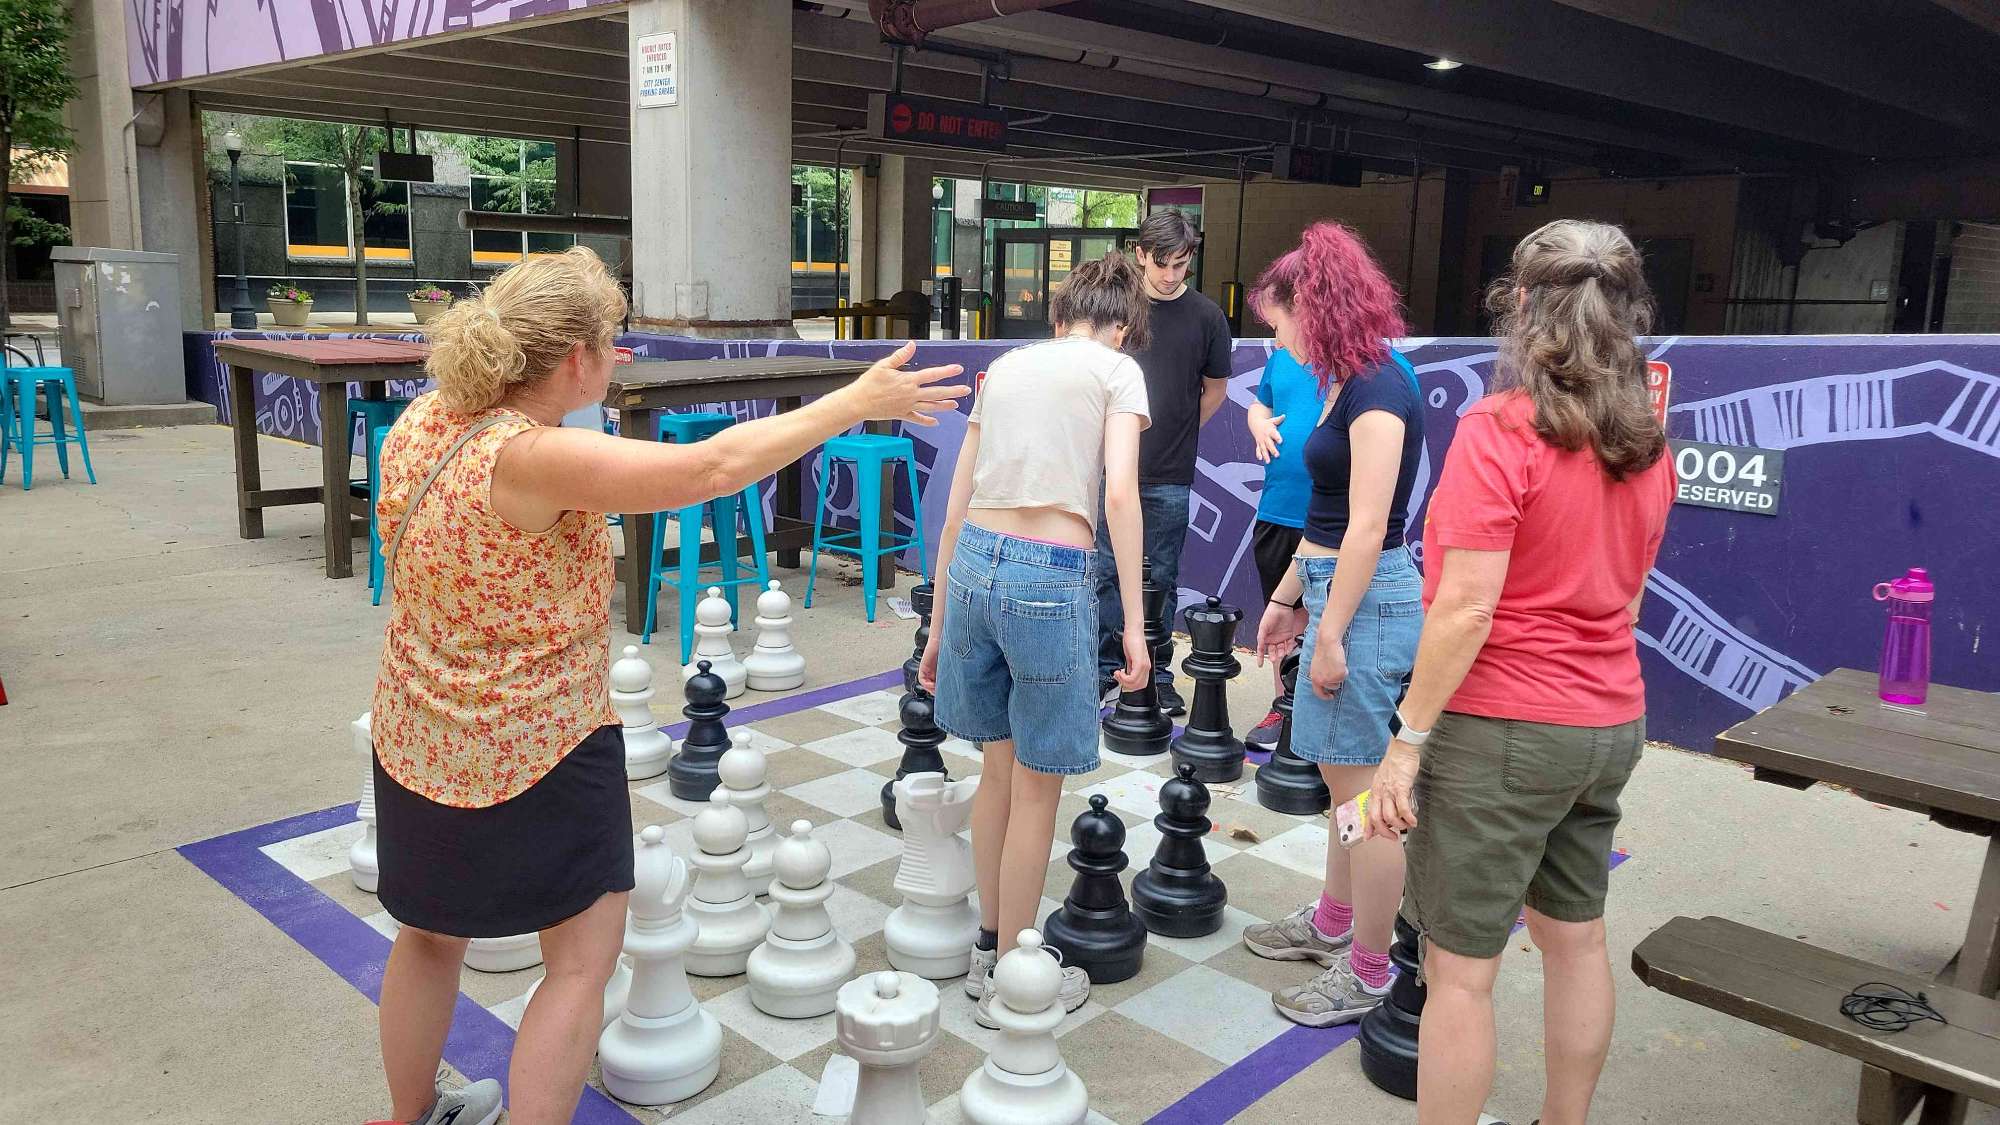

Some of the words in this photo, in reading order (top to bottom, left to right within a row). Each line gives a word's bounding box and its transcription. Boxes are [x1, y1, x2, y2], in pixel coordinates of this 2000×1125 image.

[640, 88, 658, 96] PARKING
[659, 87, 675, 95] GARAGE
[644, 80, 653, 88] CITY
[655, 78, 670, 87] CENTER
[917, 111, 936, 130] DO
[940, 115, 961, 135] NOT
[1533, 185, 1543, 195] EXIT
[1675, 447, 1767, 488] 004
[1677, 484, 1773, 509] ESERVED
